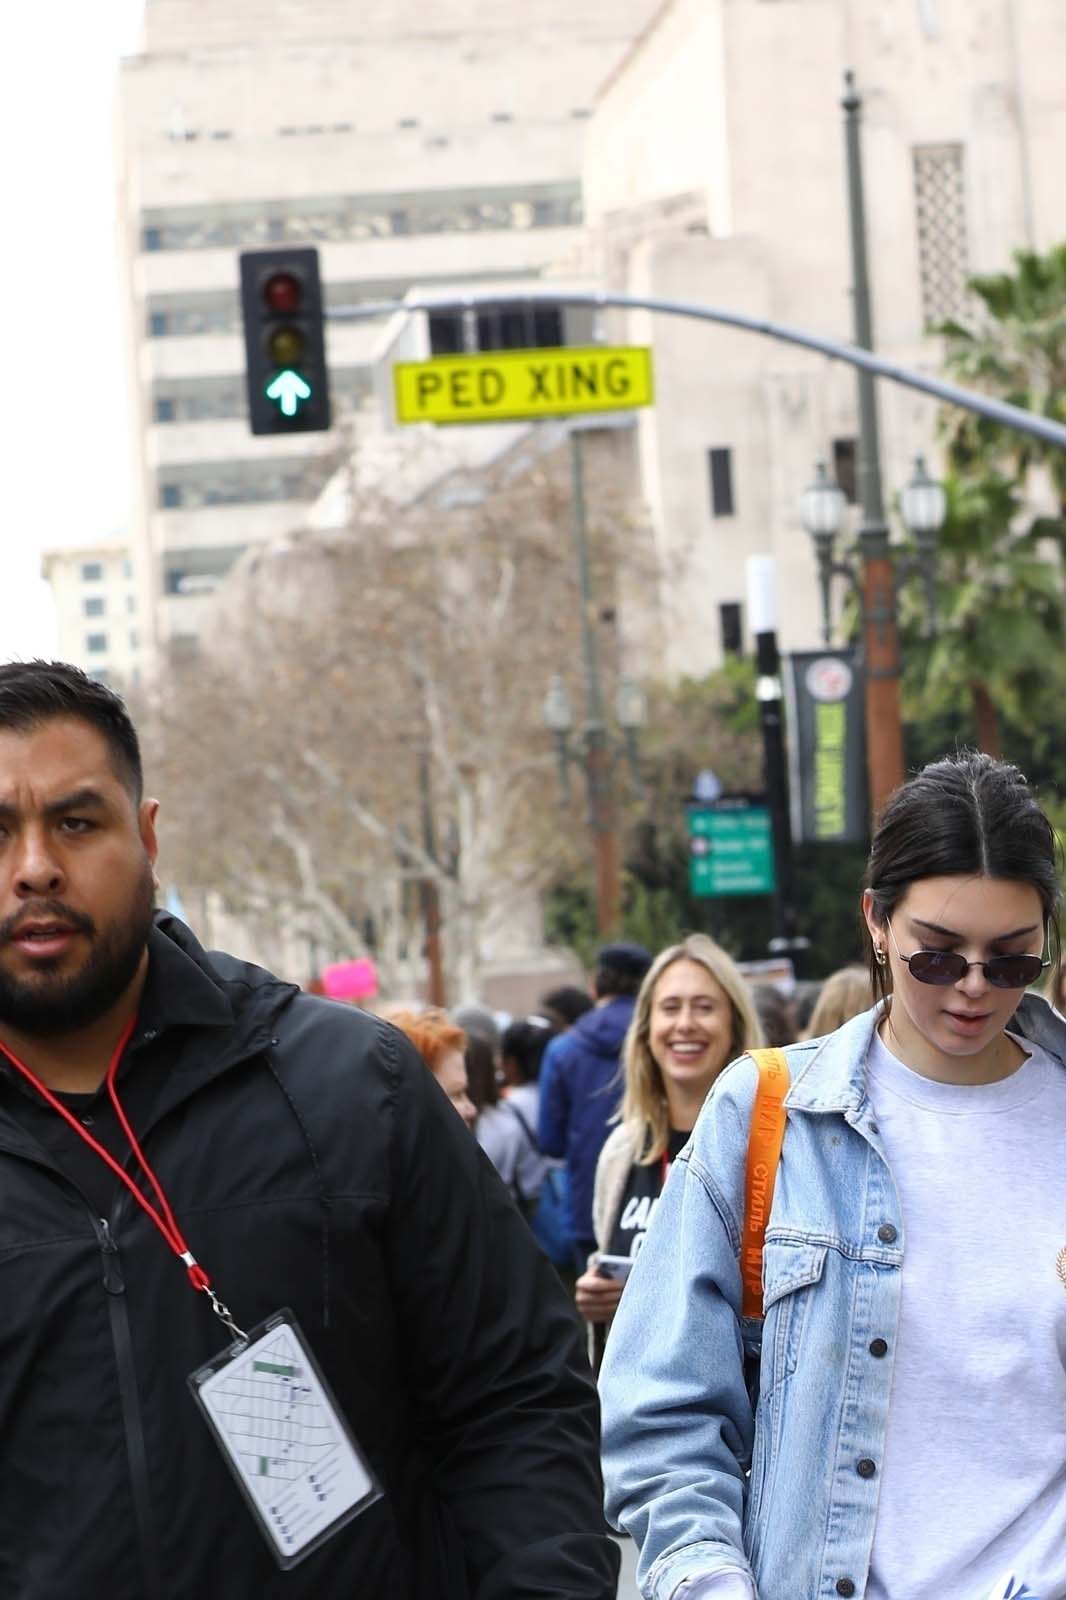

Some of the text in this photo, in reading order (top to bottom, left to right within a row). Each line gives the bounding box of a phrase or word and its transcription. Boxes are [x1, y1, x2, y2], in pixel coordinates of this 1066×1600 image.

[415, 358, 631, 413] PED XING
[749, 1162, 769, 1233] СТИЛЬ
